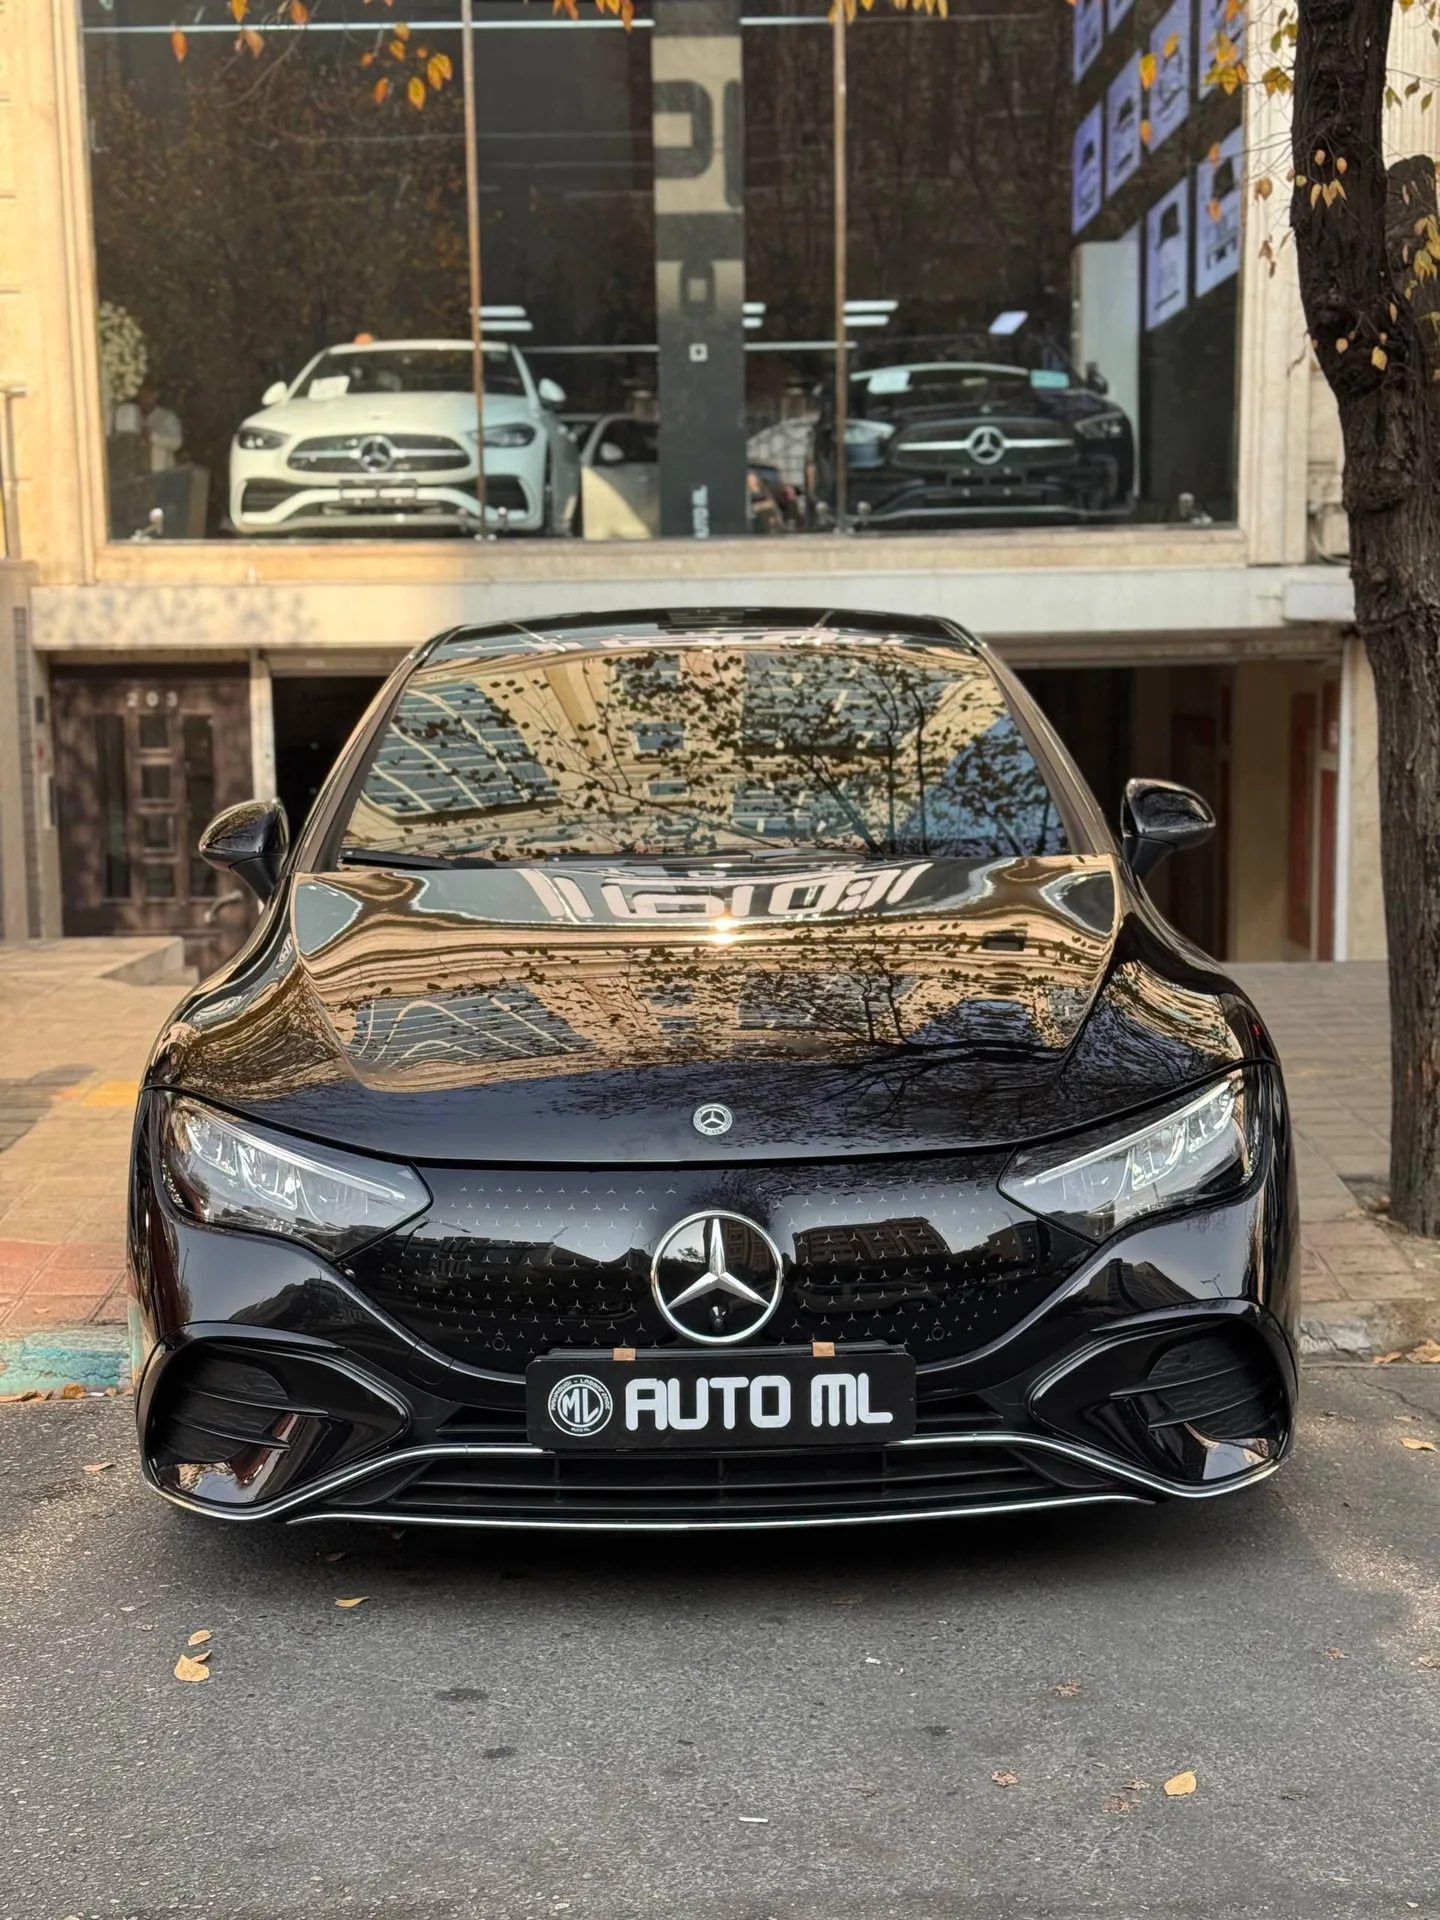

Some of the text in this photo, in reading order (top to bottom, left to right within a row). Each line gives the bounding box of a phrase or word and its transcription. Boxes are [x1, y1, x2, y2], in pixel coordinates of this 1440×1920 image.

[126, 690, 178, 707] 203
[562, 1388, 599, 1423] ML
[625, 1372, 894, 1430] AUTO ML
